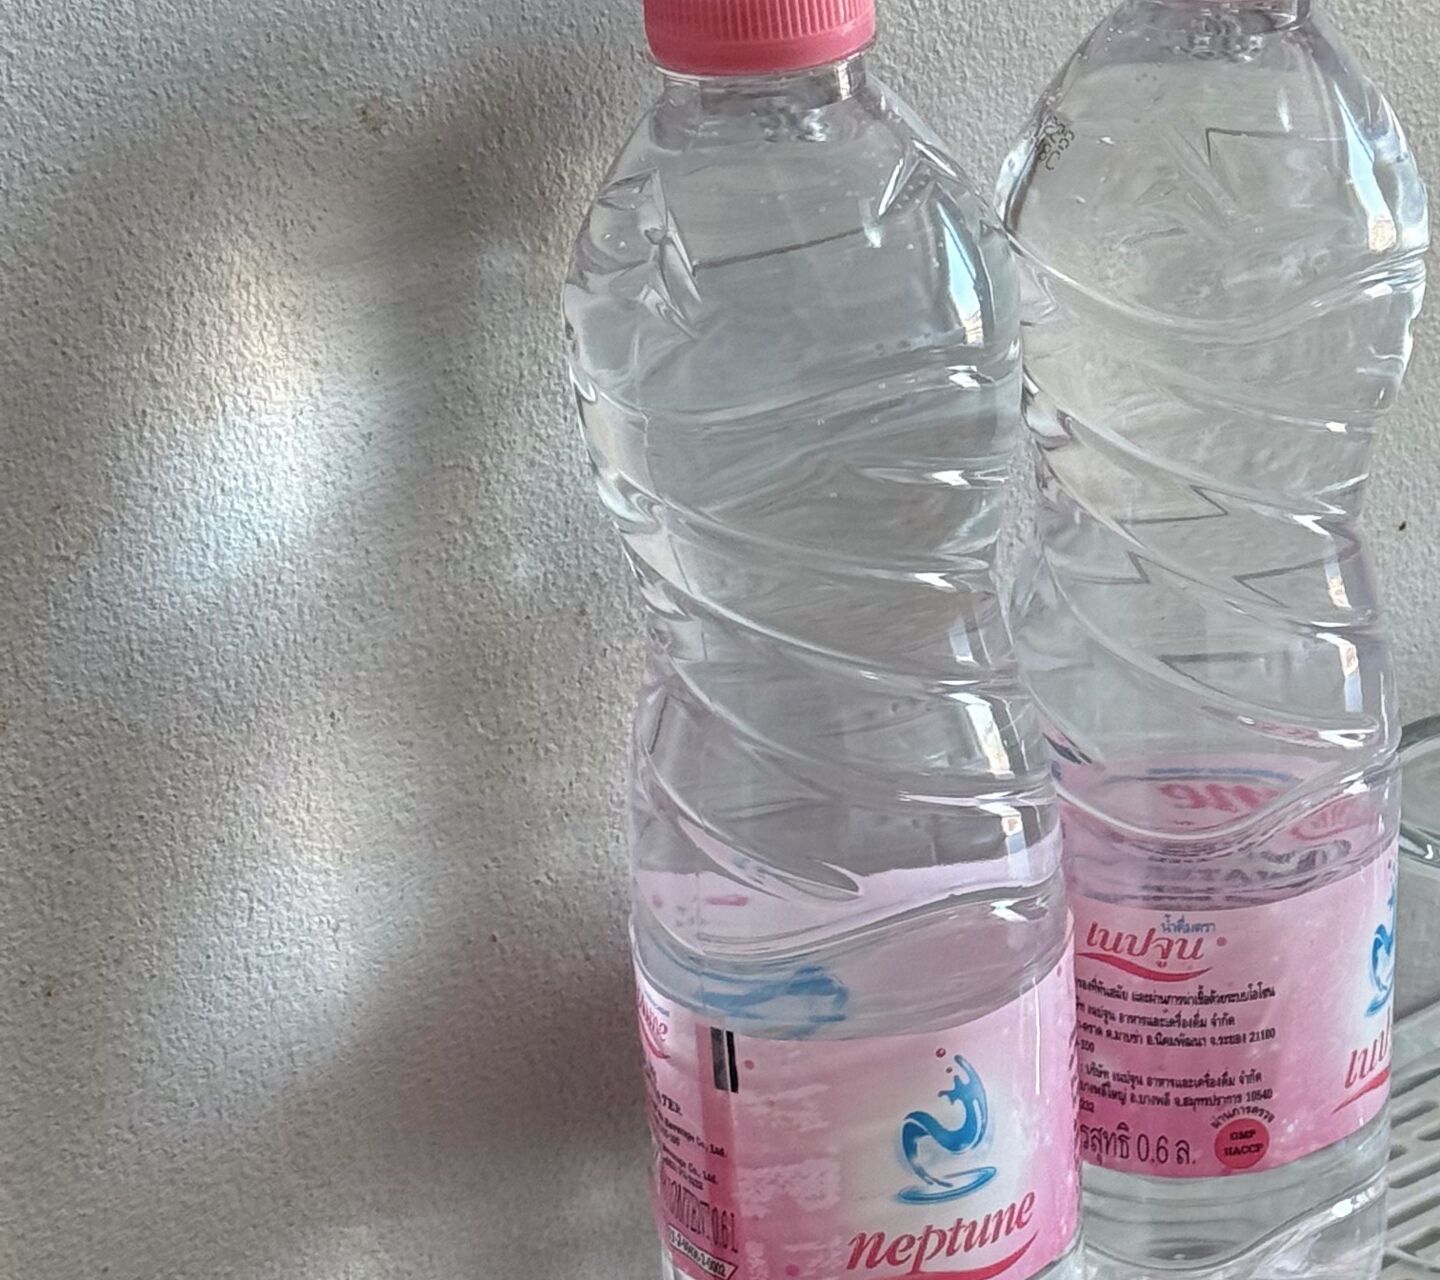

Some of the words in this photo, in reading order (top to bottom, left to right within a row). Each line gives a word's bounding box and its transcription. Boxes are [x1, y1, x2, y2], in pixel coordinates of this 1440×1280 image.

[1086, 920, 1205, 968] เนปจูน
[1136, 1132, 1170, 1165] 0.6
[1223, 1141, 1264, 1157] HACCP
[846, 1190, 1037, 1273] neptune
